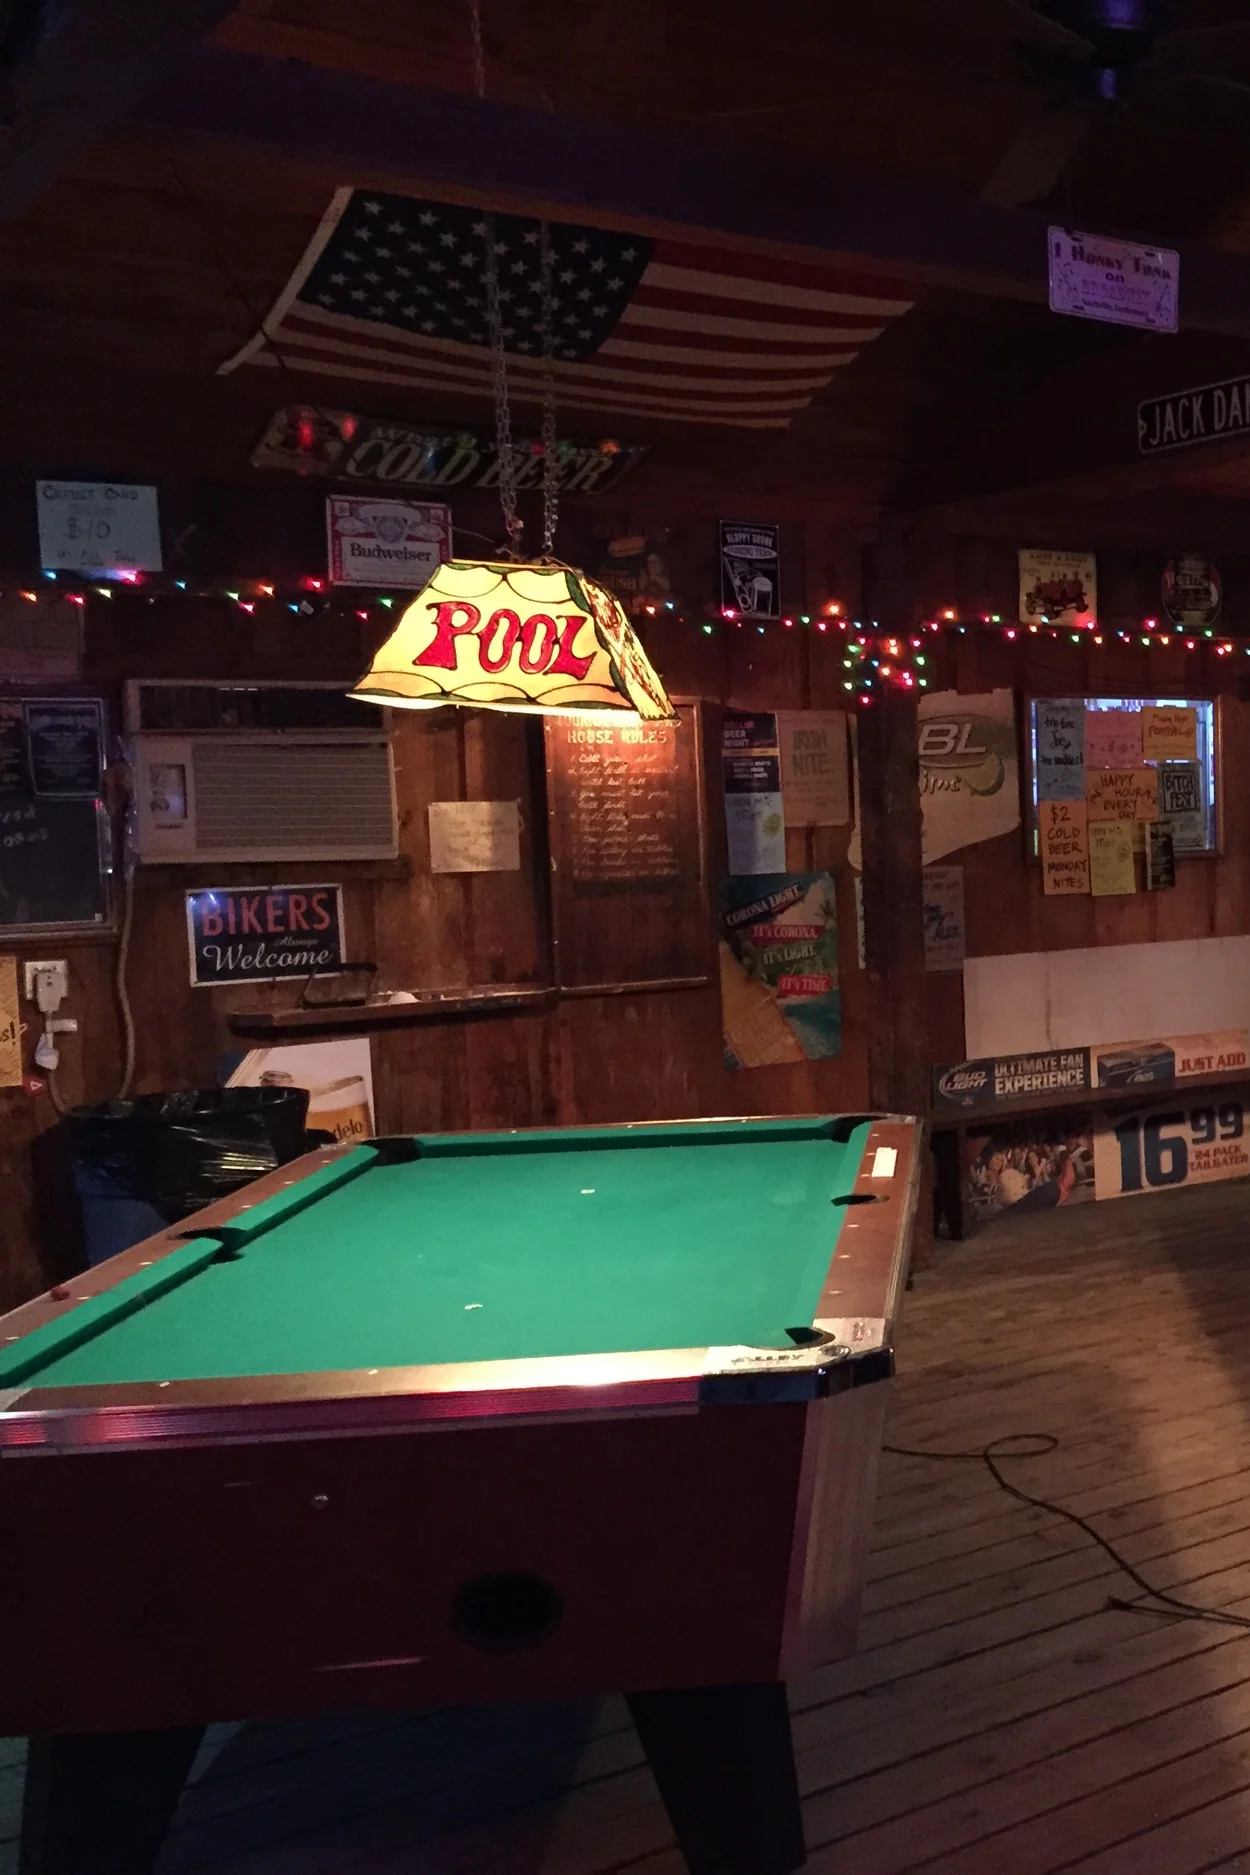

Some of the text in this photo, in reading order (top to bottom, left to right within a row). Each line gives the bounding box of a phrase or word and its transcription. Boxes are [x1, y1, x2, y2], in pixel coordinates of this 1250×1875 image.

[1148, 393, 1206, 446] JACK
[345, 438, 614, 493] COLD BEER
[350, 542, 432, 562] Budweiser
[412, 601, 598, 680] POOL
[567, 729, 667, 745] HOUSE RULES
[919, 723, 987, 755] BL
[922, 770, 962, 794] ime
[1100, 773, 1135, 788] HAPPY
[1166, 775, 1193, 794] BITCH
[1103, 799, 1137, 811] EVERY
[1170, 792, 1193, 809] FEST
[1051, 805, 1071, 825] $2
[1119, 811, 1135, 820] DAY
[1047, 827, 1080, 840] COLD
[1048, 842, 1082, 856] BEER
[1048, 860, 1087, 873] MONDAY
[1054, 877, 1084, 889] NITES
[200, 893, 330, 936] BIKERS
[726, 884, 801, 926] CORONA LIGHT
[274, 936, 319, 947] Always
[203, 943, 333, 971] Welcome
[994, 1053, 1084, 1077] ULTIMATE FAN
[1178, 1051, 1246, 1073] JUST ADD
[946, 1071, 988, 1091] BUD LIGHT
[995, 1068, 1085, 1095] EXPERIENCE
[333, 1119, 362, 1141] delo
[1115, 1102, 1244, 1193] 16 99
[1213, 1144, 1241, 1157] PACK
[1189, 1153, 1248, 1172] TAILGATER
